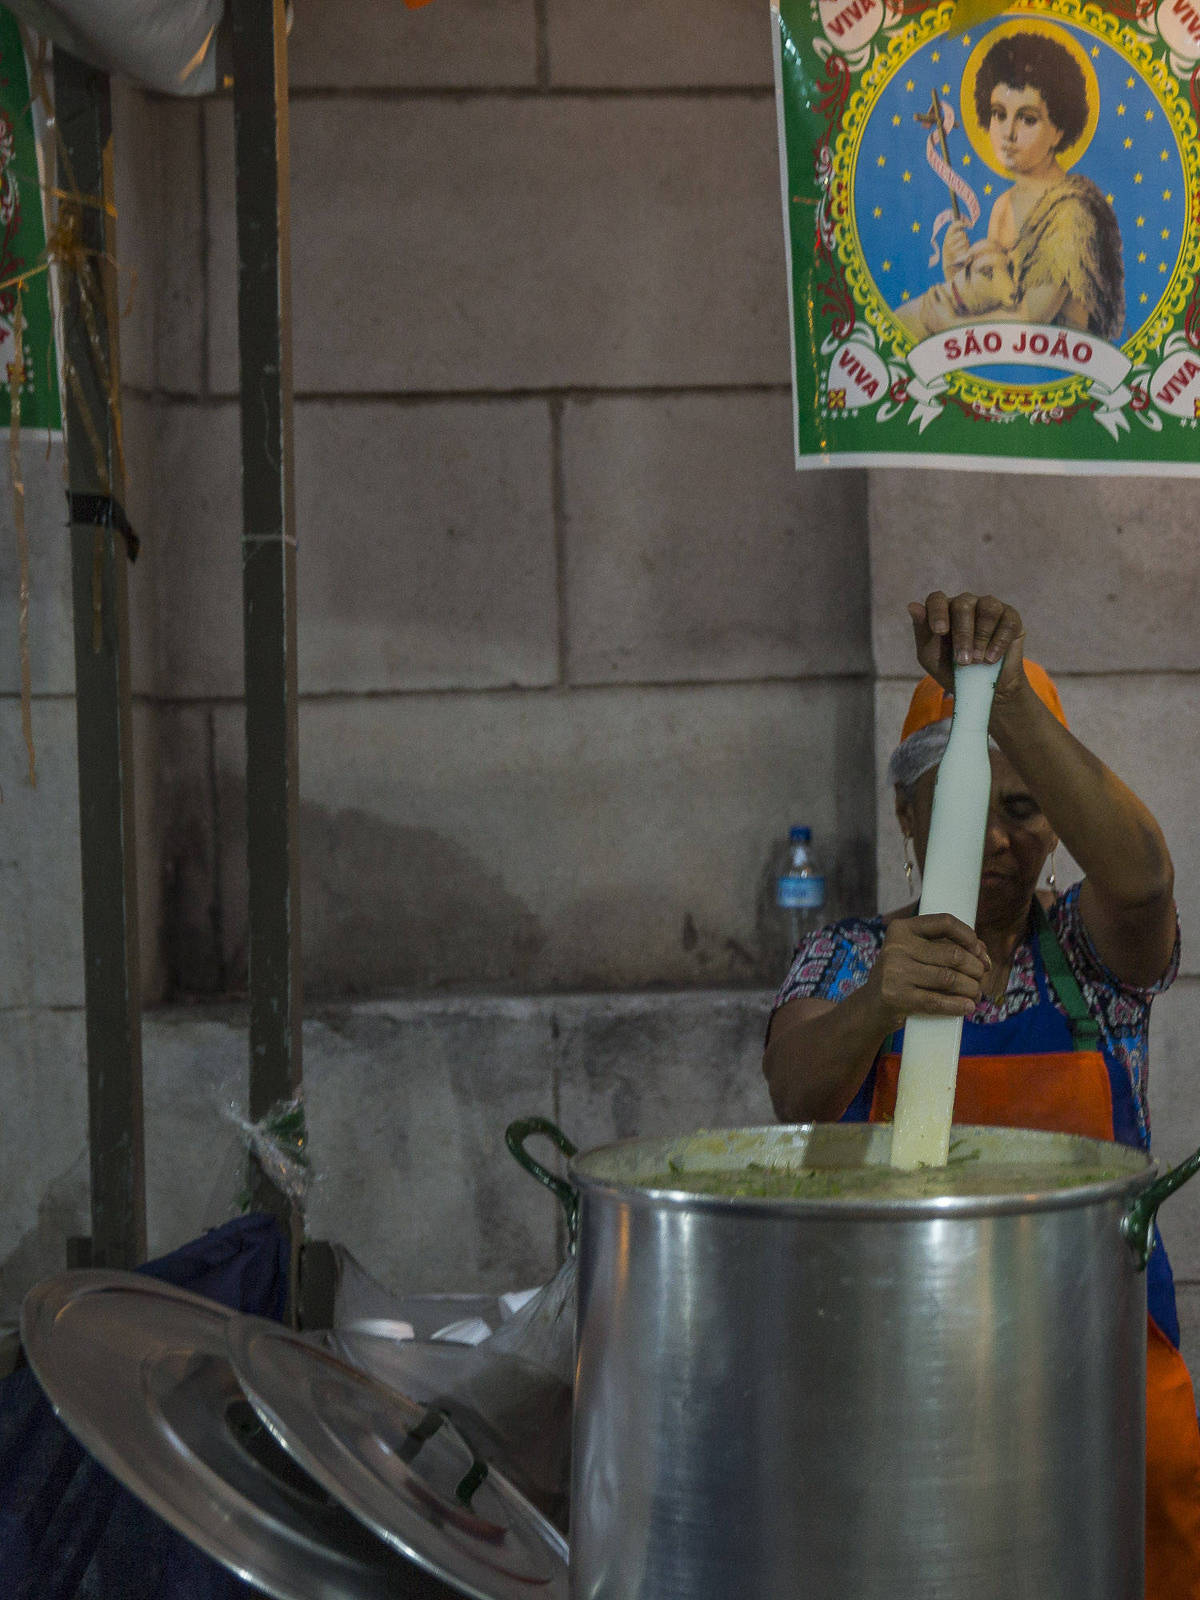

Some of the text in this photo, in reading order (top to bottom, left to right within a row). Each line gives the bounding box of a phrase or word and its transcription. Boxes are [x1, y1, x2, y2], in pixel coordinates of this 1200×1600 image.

[828, 0, 876, 37] VIVA
[944, 328, 1093, 363] SÃO JOÃO
[839, 348, 880, 399] VIVA
[1156, 359, 1200, 405] VIVA
